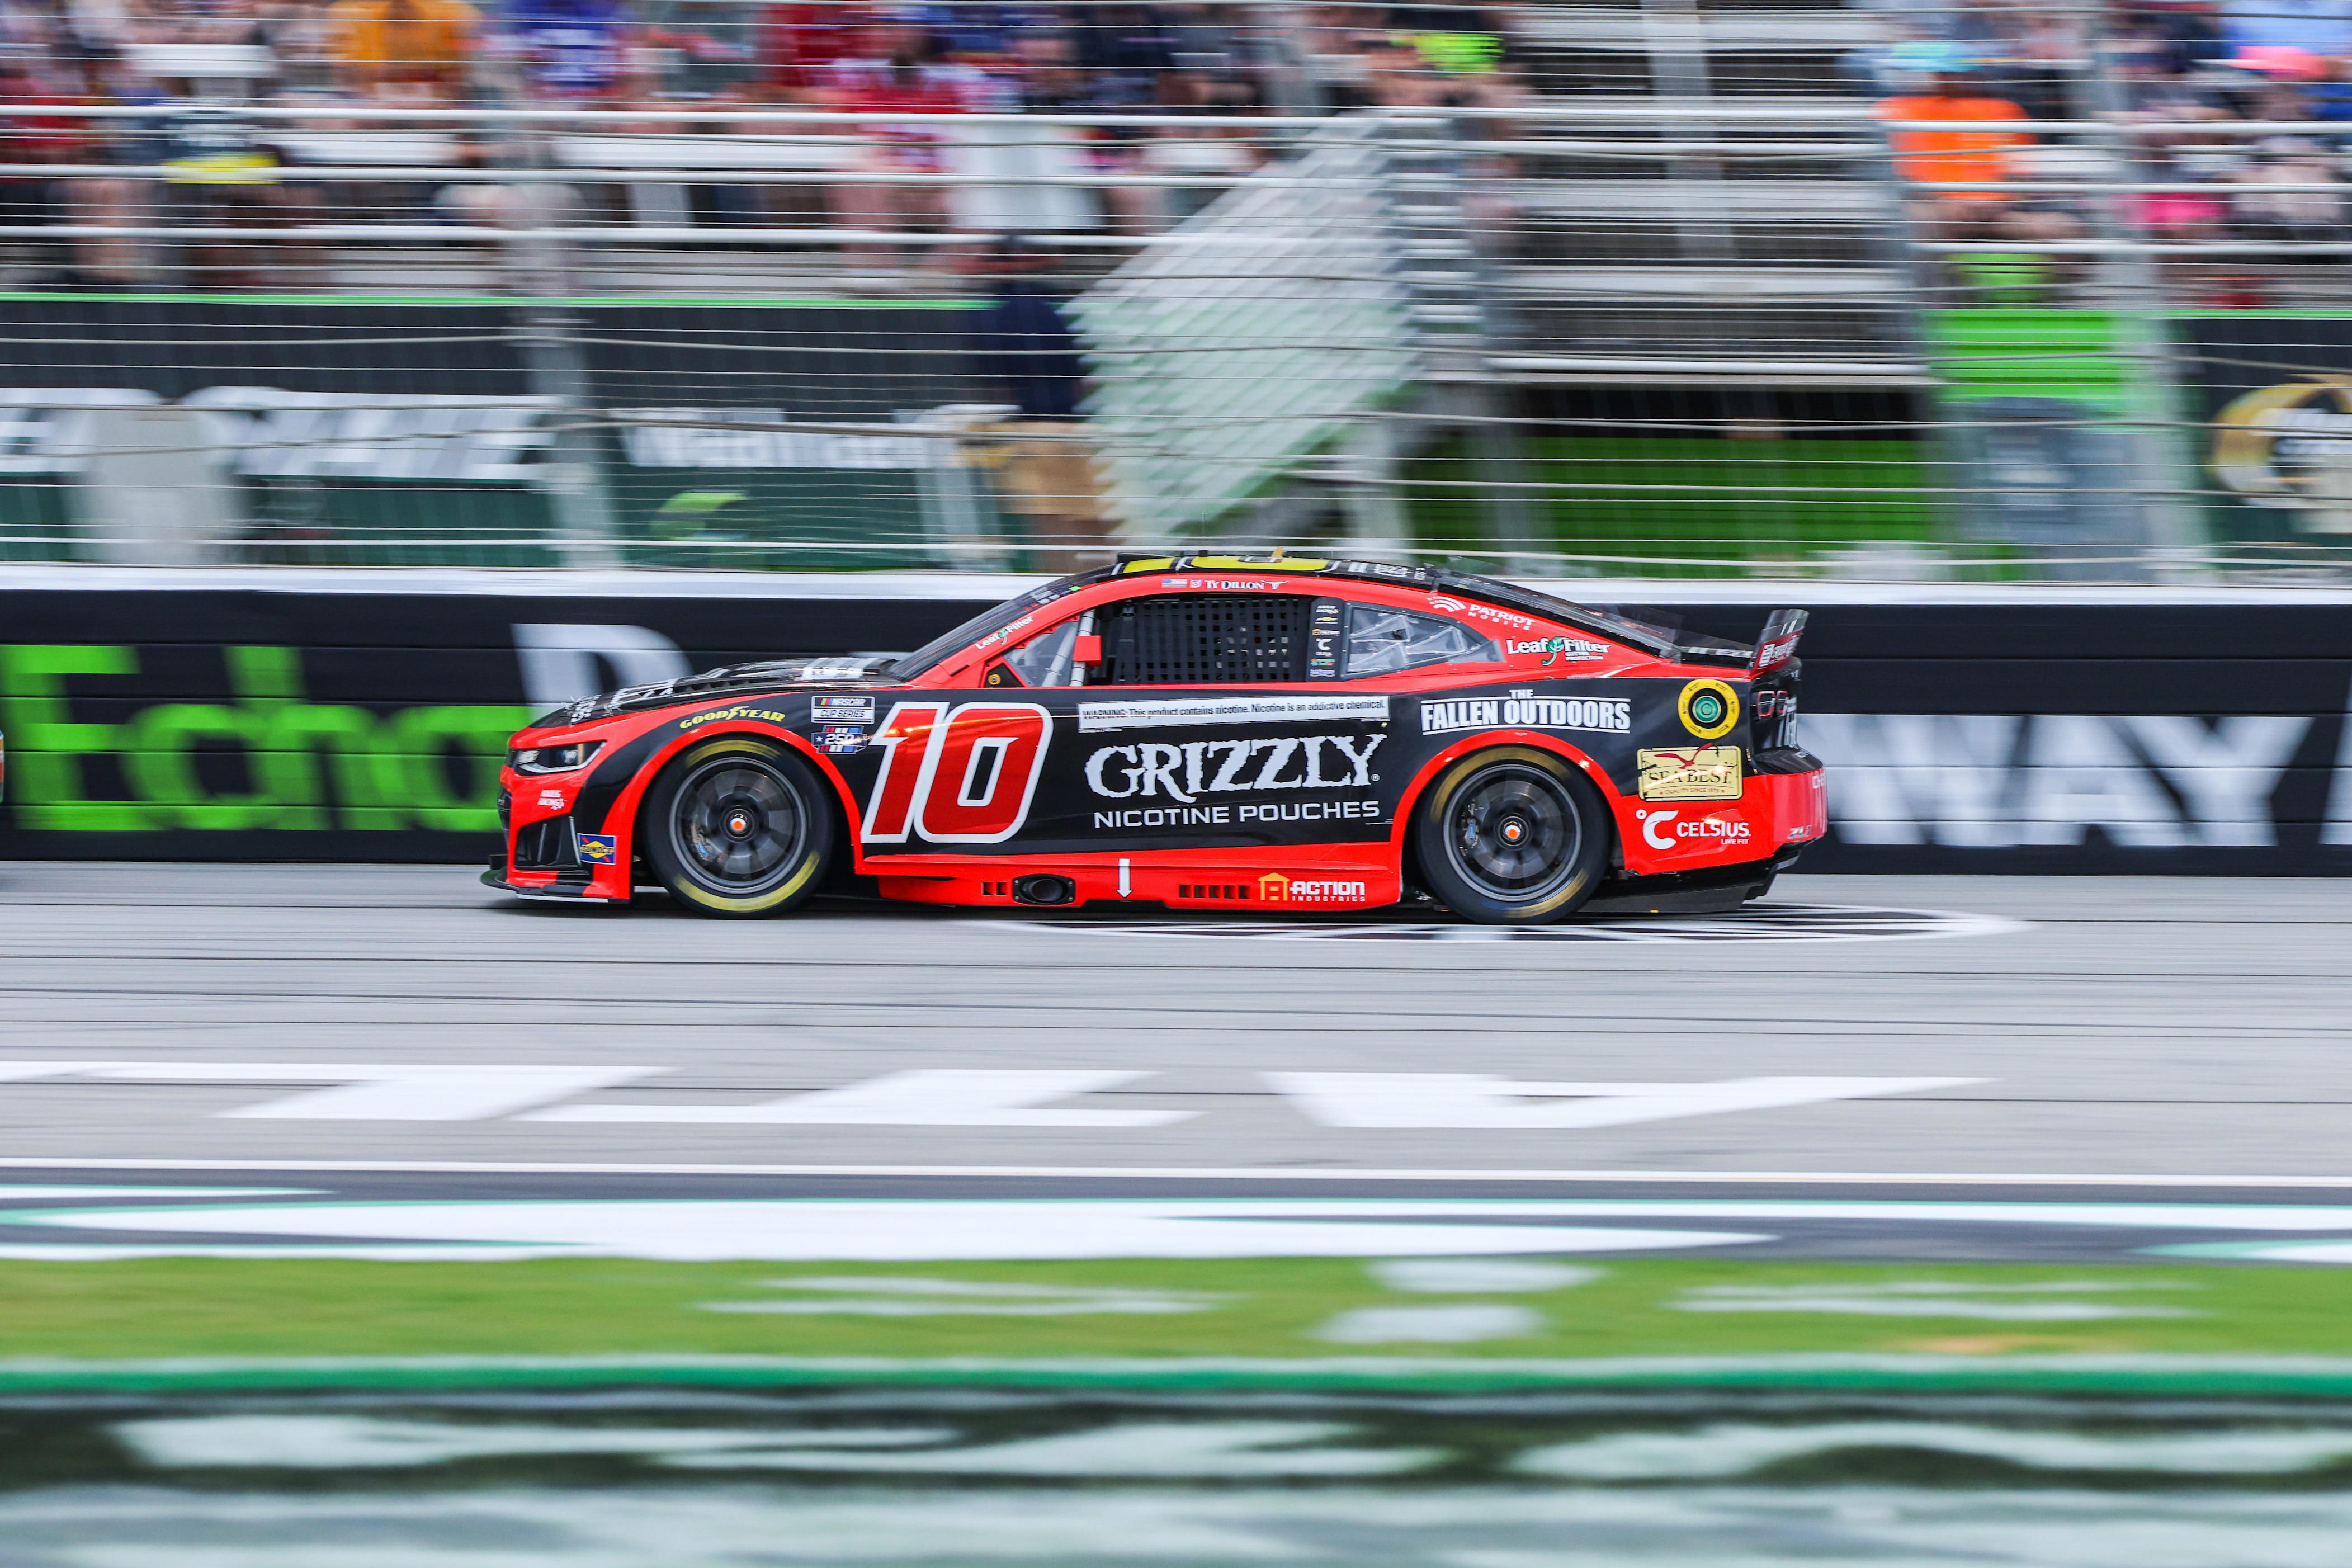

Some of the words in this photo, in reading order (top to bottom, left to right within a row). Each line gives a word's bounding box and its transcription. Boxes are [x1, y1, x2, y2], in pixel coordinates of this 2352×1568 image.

[1221, 580, 1264, 589] DILLON
[1467, 612, 1529, 630] MOBILE
[1470, 604, 1536, 625] PATRIOT
[830, 698, 866, 707] NASCAR
[1509, 689, 1534, 699] THE
[679, 706, 786, 728] GOODYEAR
[820, 709, 837, 718] CUP
[838, 709, 865, 718] SERIES
[1130, 709, 1146, 717] This
[1180, 706, 1213, 715] contains
[1216, 705, 1250, 714] nicotine.
[1251, 703, 1286, 713] Nicotine
[1287, 703, 1295, 712] is
[1308, 702, 1344, 710] addictive
[1346, 700, 1385, 710] chemical.
[1421, 701, 1499, 731] FALLEN
[1503, 700, 1631, 730] OUTDOORS
[860, 702, 1054, 844] 10
[1084, 734, 1388, 803] GRIZZLY
[1687, 769, 1732, 784] BEST
[1094, 806, 1230, 828] NICOTINE
[1239, 801, 1380, 823] POUCHES
[1676, 821, 1749, 837] CELSIUS
[1290, 881, 1365, 895] ACTION
